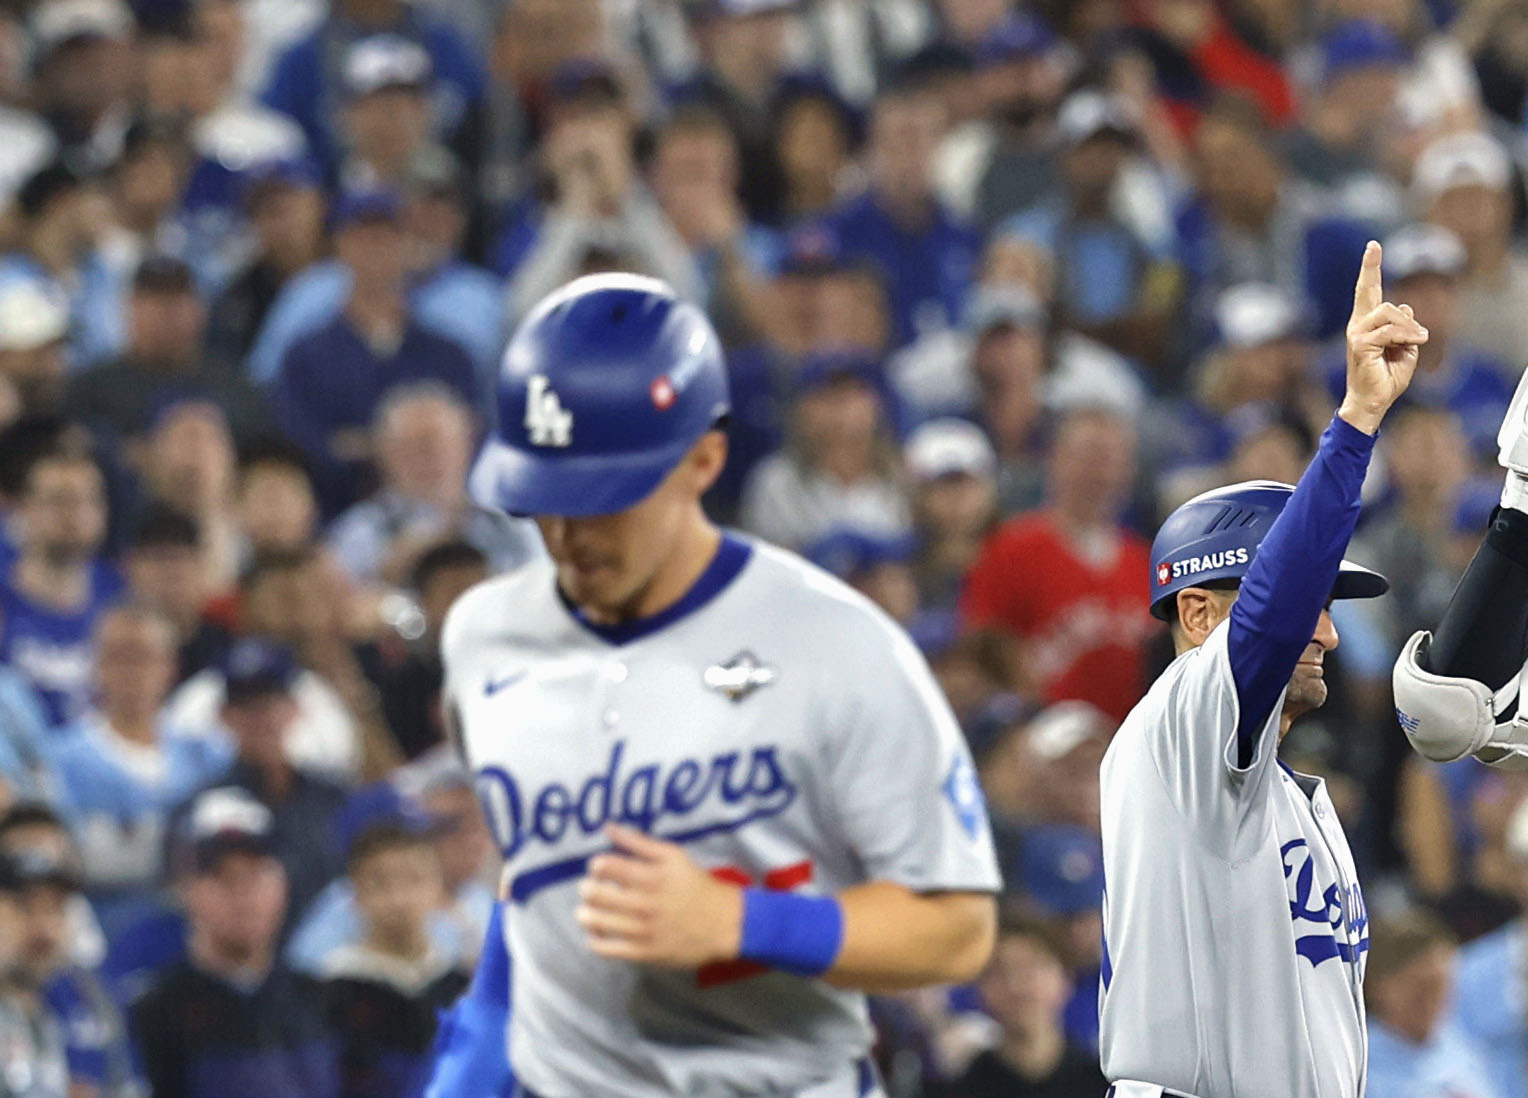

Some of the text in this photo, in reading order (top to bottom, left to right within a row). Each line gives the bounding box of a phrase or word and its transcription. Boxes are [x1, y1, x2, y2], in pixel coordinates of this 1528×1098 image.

[525, 375, 574, 447] LA
[1172, 547, 1249, 578] STRAUSS
[479, 739, 799, 862] Dodgers
